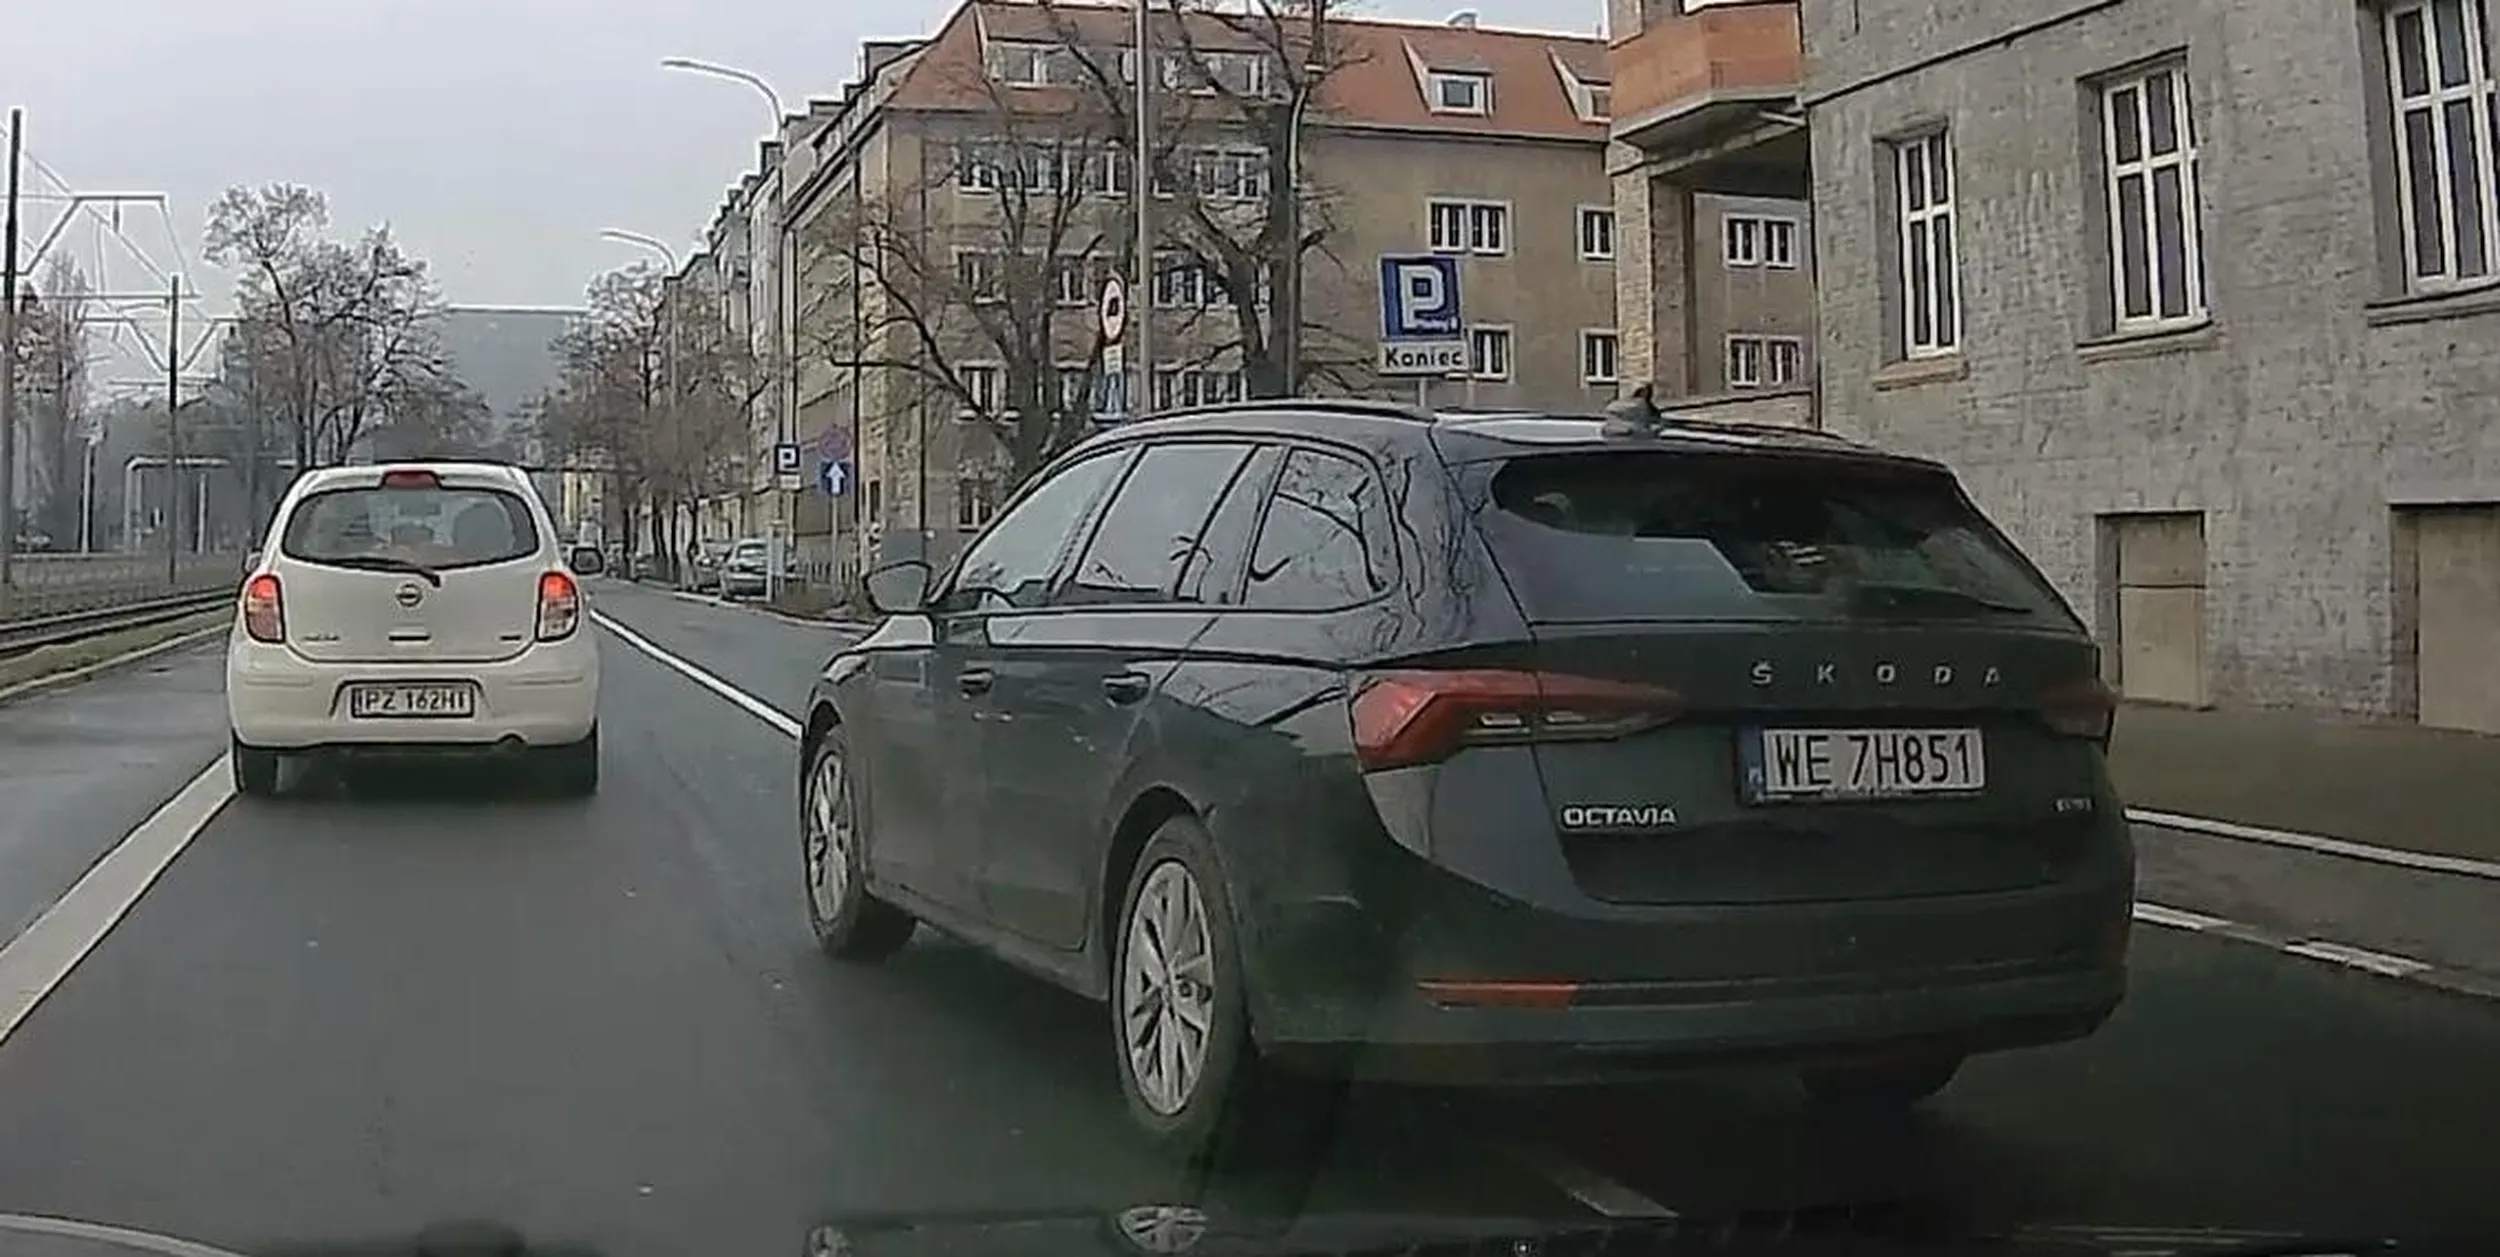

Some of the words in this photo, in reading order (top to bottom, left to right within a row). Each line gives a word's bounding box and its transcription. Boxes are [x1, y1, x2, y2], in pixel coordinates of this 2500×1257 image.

[1399, 264, 1445, 328] P
[1385, 348, 1463, 368] Koniec
[778, 447, 797, 471] P
[1751, 660, 2001, 685] ŠKODA
[365, 689, 397, 710] PZ
[1775, 733, 1833, 787] WE
[1847, 733, 1970, 787] 7H851
[1563, 807, 1678, 825] OCTAVIA
